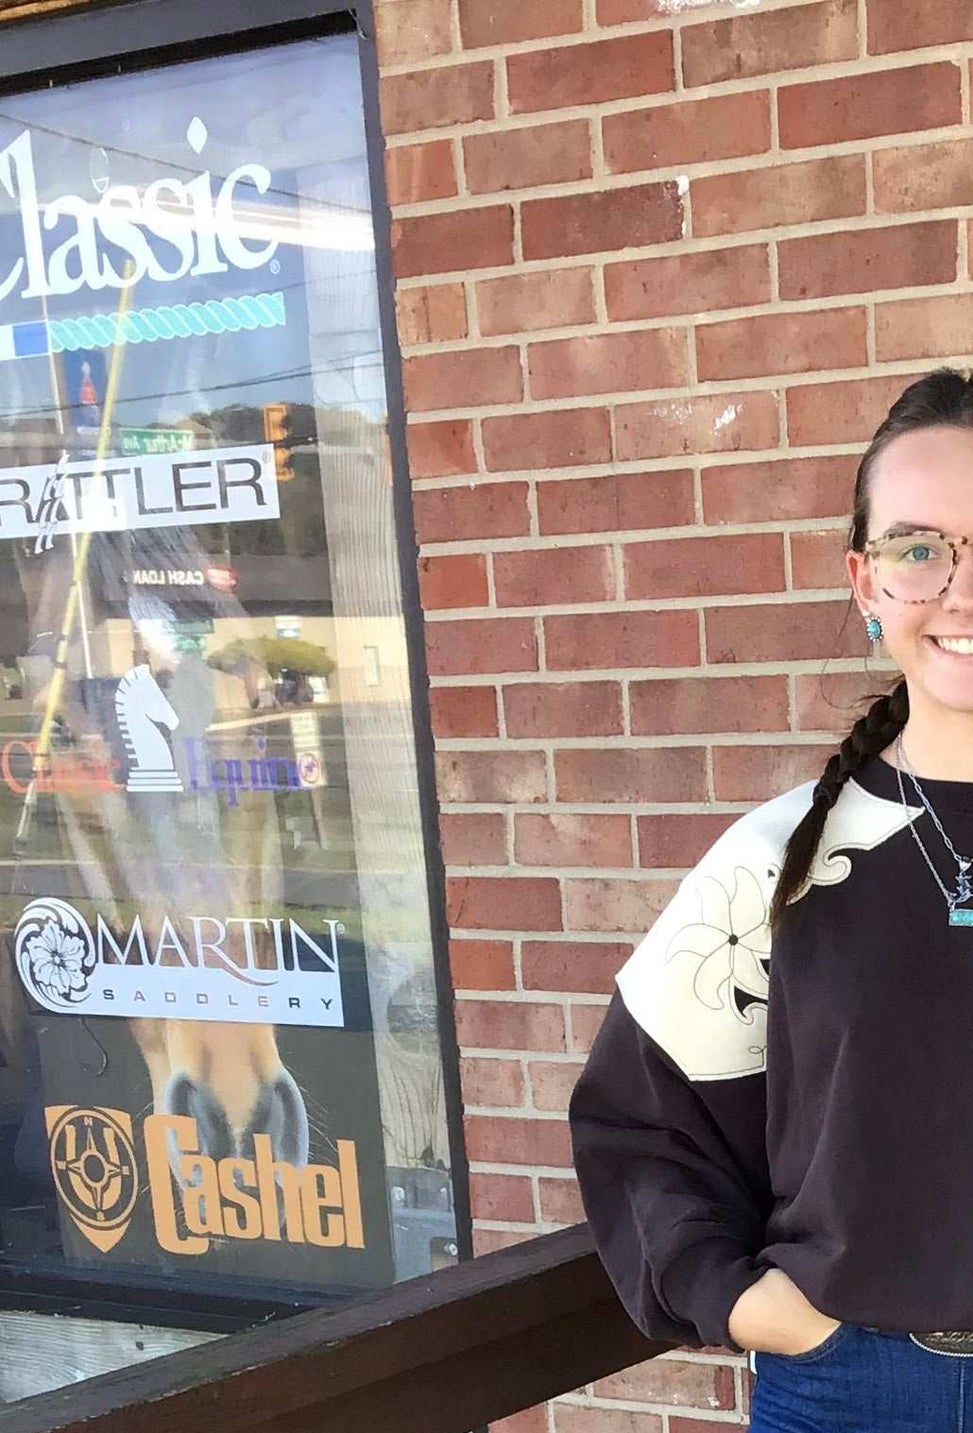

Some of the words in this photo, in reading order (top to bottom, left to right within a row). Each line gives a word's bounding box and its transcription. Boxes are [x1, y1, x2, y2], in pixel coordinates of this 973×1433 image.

[0, 457, 268, 528] RATTLER
[96, 912, 341, 986] MARTIN
[102, 988, 334, 1011] SADDLERY
[143, 1113, 366, 1256] Cashel
